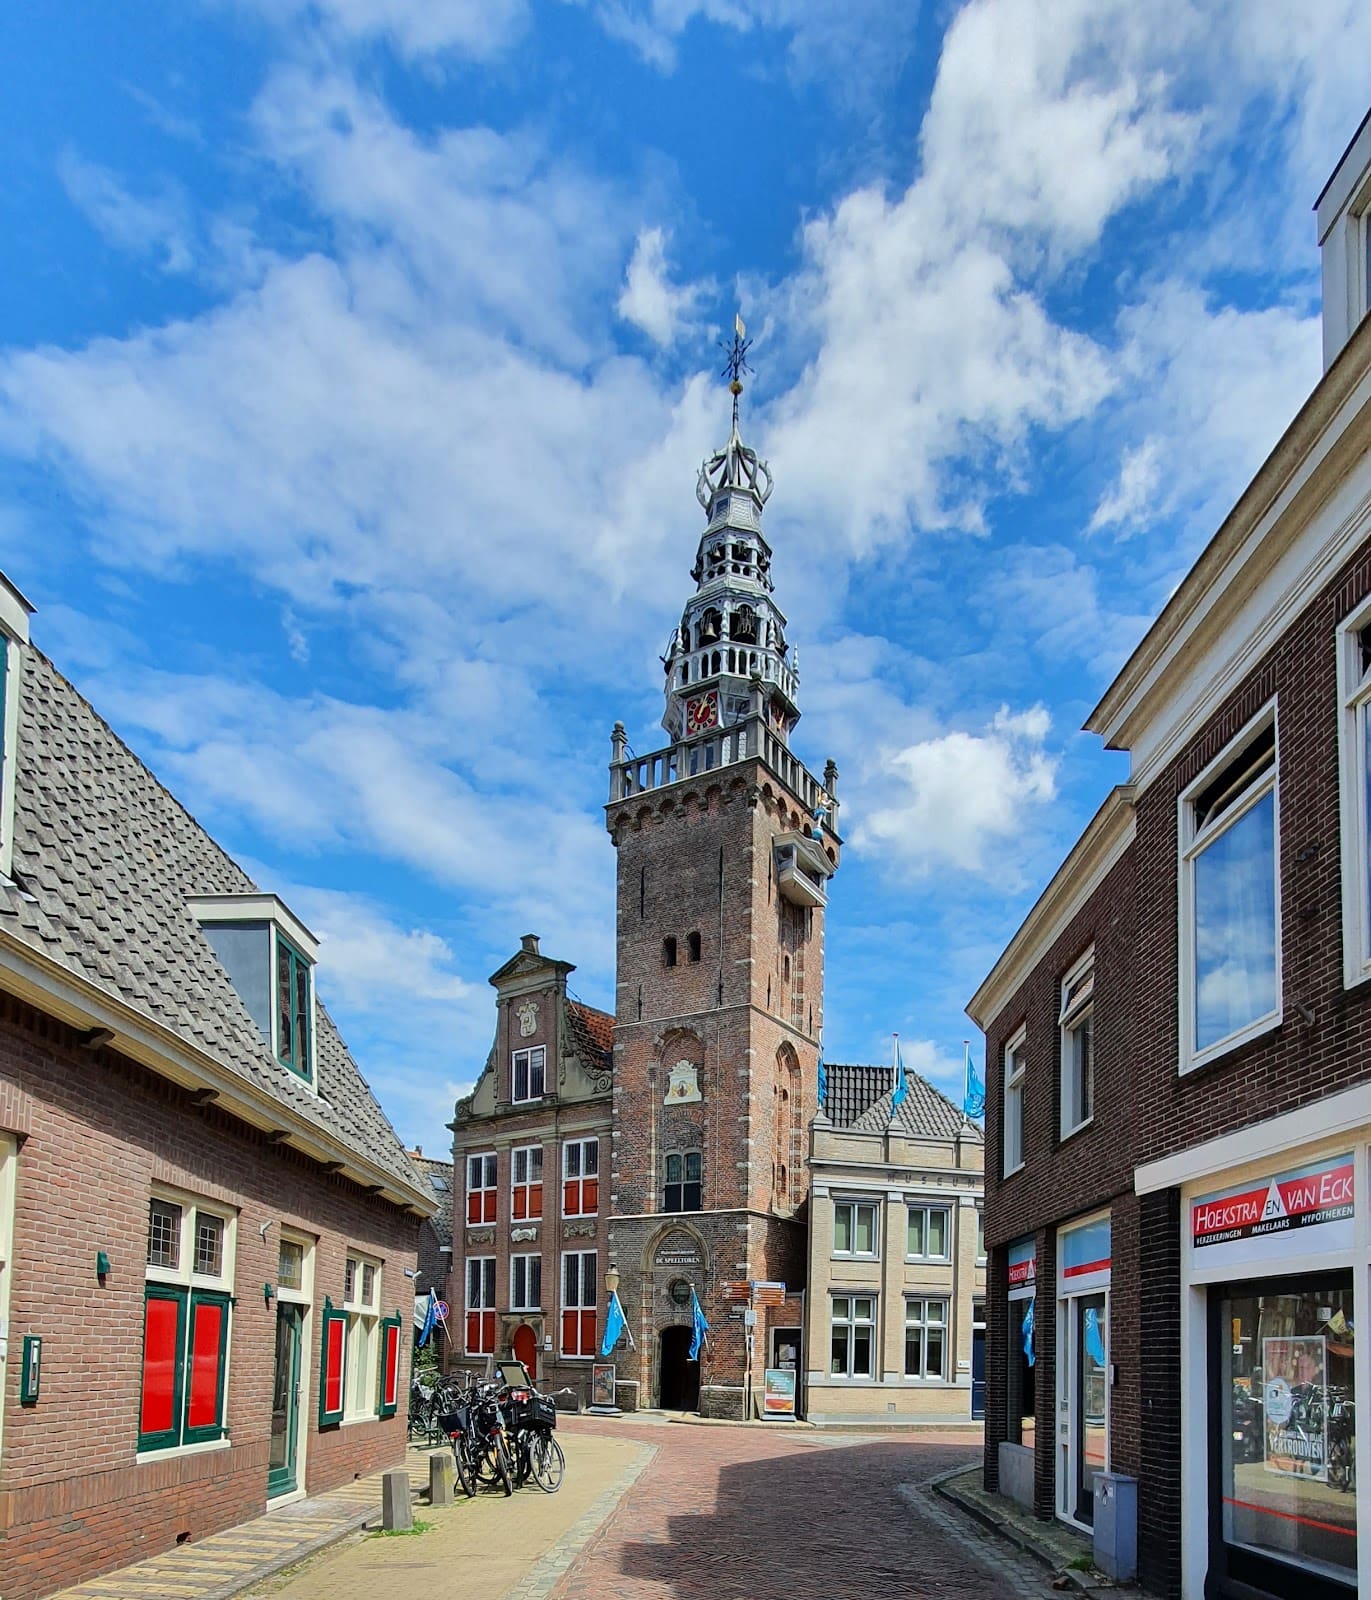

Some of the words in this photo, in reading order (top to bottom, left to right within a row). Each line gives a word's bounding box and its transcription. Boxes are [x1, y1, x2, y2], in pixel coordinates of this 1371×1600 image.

[887, 1173, 976, 1188] MUSEUM
[1196, 1200, 1258, 1232] HOEKSTRA
[1265, 1199, 1281, 1215] EN
[1287, 1187, 1316, 1210] VAN
[1319, 1174, 1353, 1205] ECK
[1196, 1229, 1242, 1246] VERZEKERINGEN
[1251, 1219, 1290, 1235] MAKELAARS
[1301, 1205, 1354, 1225] HYPOTHEKEN
